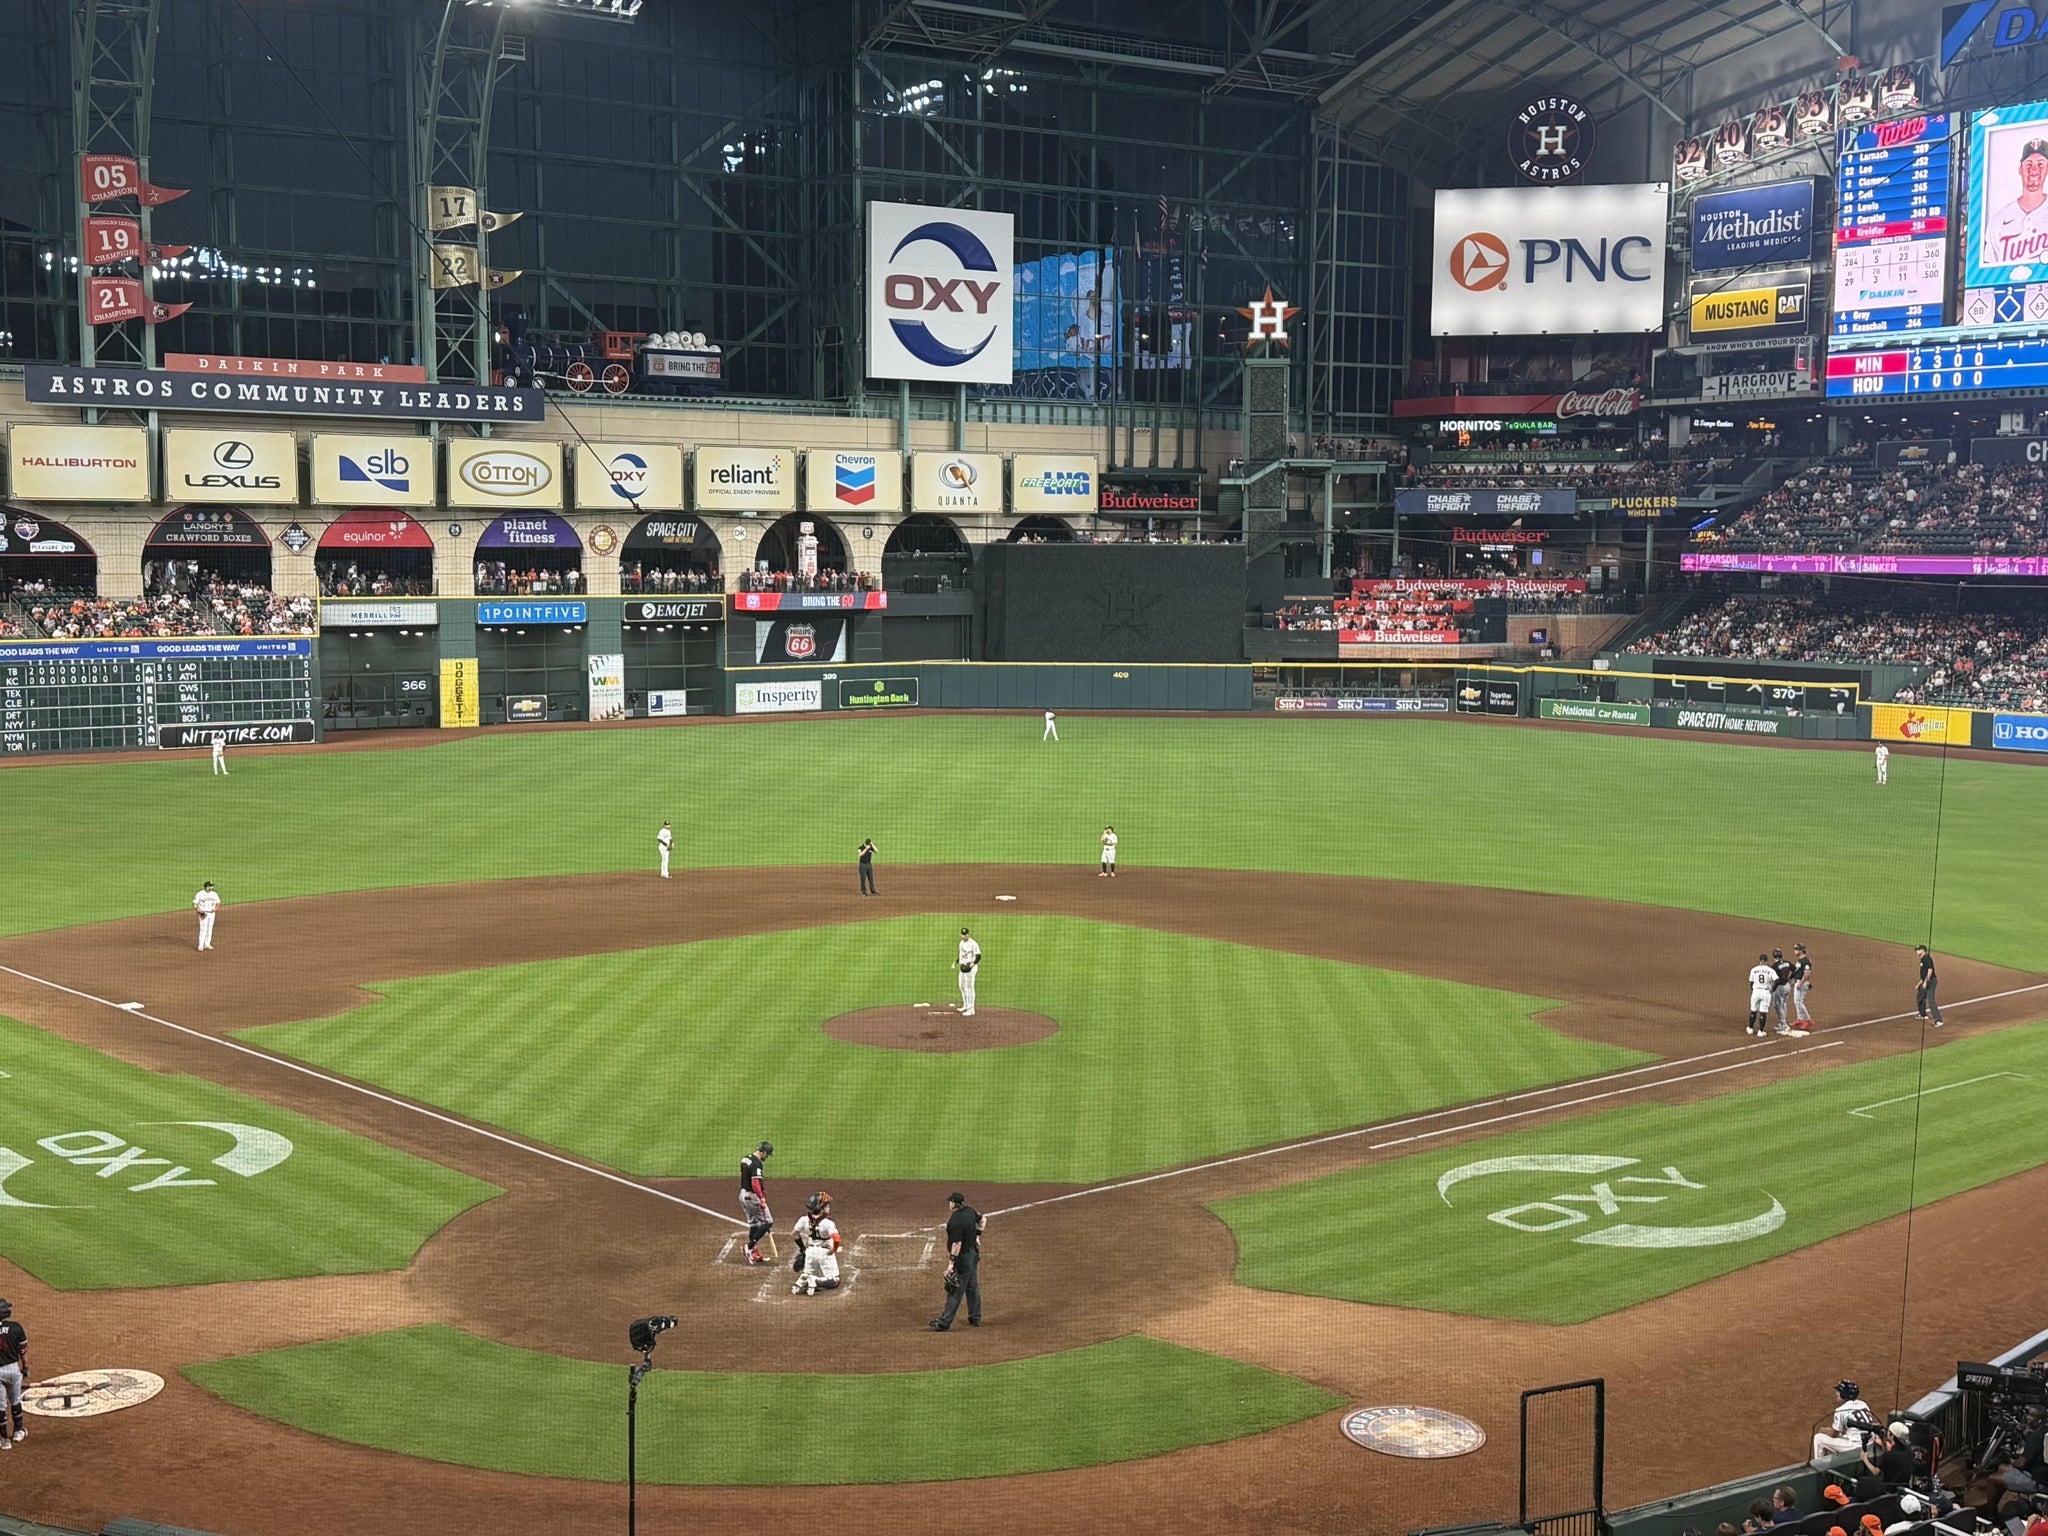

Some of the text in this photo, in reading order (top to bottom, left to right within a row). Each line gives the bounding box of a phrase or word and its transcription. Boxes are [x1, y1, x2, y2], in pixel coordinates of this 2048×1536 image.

[1880, 63, 1912, 92] 42
[1838, 75, 1869, 106] 34
[1518, 98, 1587, 125] HOUSTON
[1796, 90, 1824, 119] 33
[1755, 105, 1782, 132] 25
[1535, 125, 1568, 155] H
[1714, 121, 1741, 149] 40
[1872, 116, 1927, 149] Twins
[1675, 138, 1701, 165] 32
[1520, 157, 1581, 179] ASTROS
[93, 164, 127, 189] 05
[91, 186, 138, 201] CHAMPIONS
[440, 196, 466, 218] 17
[1700, 209, 1741, 223] HOUSTON
[1700, 209, 1803, 243] Methodist
[98, 228, 129, 251] 19
[1726, 235, 1802, 251] LEADING MEDICINE
[94, 248, 139, 263] CHAMPIONS
[1518, 235, 1652, 284] PNC
[1842, 249, 1940, 267] .284 23 .360
[441, 256, 467, 276] 22
[1844, 270, 1939, 287] 29 11 .500
[99, 287, 129, 309] 21
[884, 274, 1001, 314] OXY
[1868, 288, 1905, 300] DAIKIN
[93, 307, 137, 322] CHAMPIONS
[1705, 294, 1804, 321] MUSTANG CAT
[1247, 300, 1289, 340] H
[1706, 338, 1788, 351] KNOW WHO'S ON YOUR
[198, 357, 385, 378] DAIKIN PARK
[668, 361, 717, 373] BRING THE GO
[1855, 352, 1984, 373] MIN 2 3 0 0
[1718, 372, 1798, 396] HARGROVE
[1853, 371, 1983, 394] HOU 0 0 0
[49, 375, 524, 413] ASTROS COMMUNITY LEADERS
[1439, 420, 1554, 432] HORNITOS BAR
[21, 456, 137, 468] HALLIBURTON
[367, 448, 410, 476] slb
[835, 453, 876, 465] Chevron
[1496, 451, 1550, 461] HORNITOS
[184, 473, 281, 489] LEXUS
[471, 460, 538, 487] COTTON
[610, 470, 646, 482] OXY
[710, 464, 774, 485] reliant
[1019, 471, 1091, 496] FREEPORT LNG
[937, 495, 979, 507] QUANTA
[1100, 491, 1199, 509] Budweiser
[1427, 494, 1463, 503] CHASE
[1427, 501, 1472, 511] THE FIGHT
[1496, 494, 1533, 503] CHASE
[1611, 496, 1678, 509] PLUCKERS
[1496, 501, 1541, 512] THE FIGHT
[1627, 509, 1646, 518] WING
[503, 519, 548, 533] planet
[646, 522, 699, 537] SPACE CITY
[734, 529, 746, 537] DK
[165, 533, 252, 543] CRAWFORD BOXES
[342, 531, 387, 543] equinor
[509, 531, 555, 543] fitness
[1452, 526, 1545, 543] Budweiser
[1700, 554, 1845, 572] PEARSON K
[1814, 562, 1898, 573] 10 SINKER
[1395, 579, 1567, 592] Budweiser Budweiser
[802, 596, 826, 607] BRING
[826, 596, 840, 607] THE
[484, 606, 581, 620] 1POINTFIVE
[656, 603, 708, 620] EMCJET
[790, 638, 810, 650] 66
[1374, 631, 1445, 643] Budweiser
[18, 647, 44, 656] LEADS
[44, 647, 60, 655] THE
[60, 646, 80, 655] WAY
[156, 645, 181, 653] GOOD
[182, 644, 207, 652] LEADS
[207, 644, 222, 652] THE
[7, 663, 197, 676] TB LAD
[5, 673, 197, 686] KC ATH
[401, 680, 427, 691] 366
[591, 676, 620, 686] WM
[5, 684, 199, 698] TEX CWS
[455, 662, 464, 719] DOGGETT
[756, 687, 818, 705] Insperity
[1489, 690, 1512, 700] Together
[1772, 688, 1796, 700] 370
[5, 693, 197, 708] CLE BAL
[145, 666, 155, 744] AMERICAN
[849, 693, 909, 705] Huntington Bank
[6, 705, 199, 720] DET WSH
[1561, 704, 1637, 720] National Car Rental
[5, 714, 197, 729] NYY BOS
[1677, 710, 1705, 728] SPACE
[1705, 712, 1727, 729] CITY
[1724, 719, 1745, 730] HOME
[1745, 720, 1779, 734] NETWORK
[4, 733, 25, 741] NYM
[181, 724, 293, 745] NITTOTIRE.COM
[2014, 726, 2048, 739] HO
[6, 743, 23, 751] TOR
